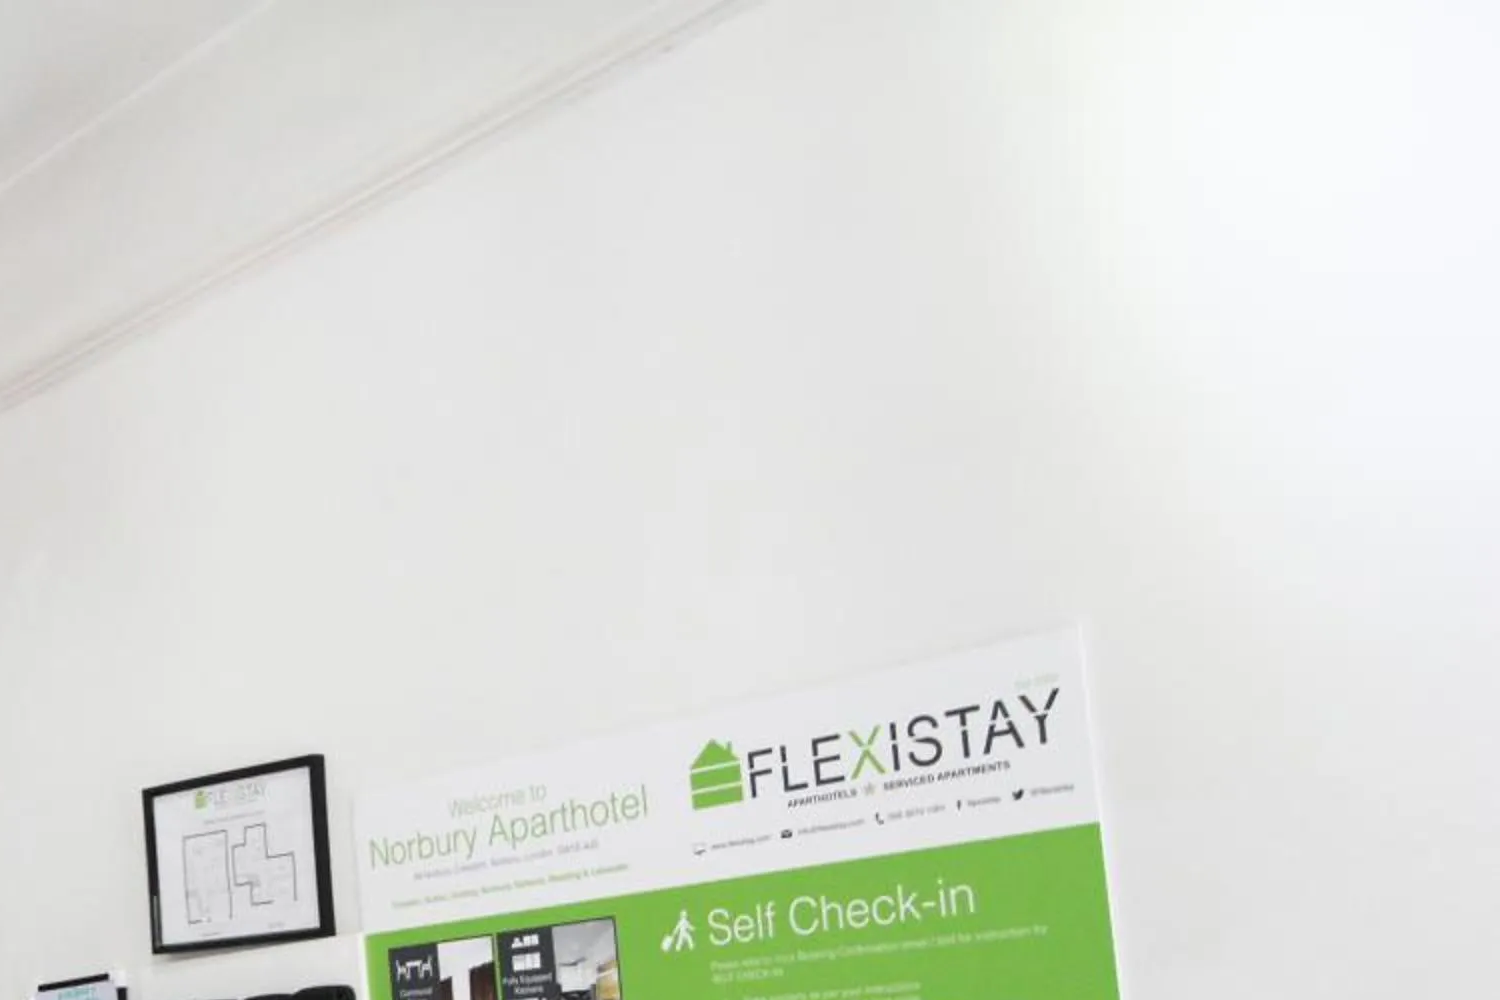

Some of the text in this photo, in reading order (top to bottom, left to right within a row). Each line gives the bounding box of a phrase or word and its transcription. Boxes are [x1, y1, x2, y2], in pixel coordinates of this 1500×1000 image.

[747, 688, 1060, 799] FLEXISTAY
[787, 760, 1011, 808] APARTHOTELS SERVICED APARTMENTS
[368, 826, 477, 871] Norbury
[488, 783, 648, 851] Aparthotel
[706, 876, 977, 946] Self Check-in
